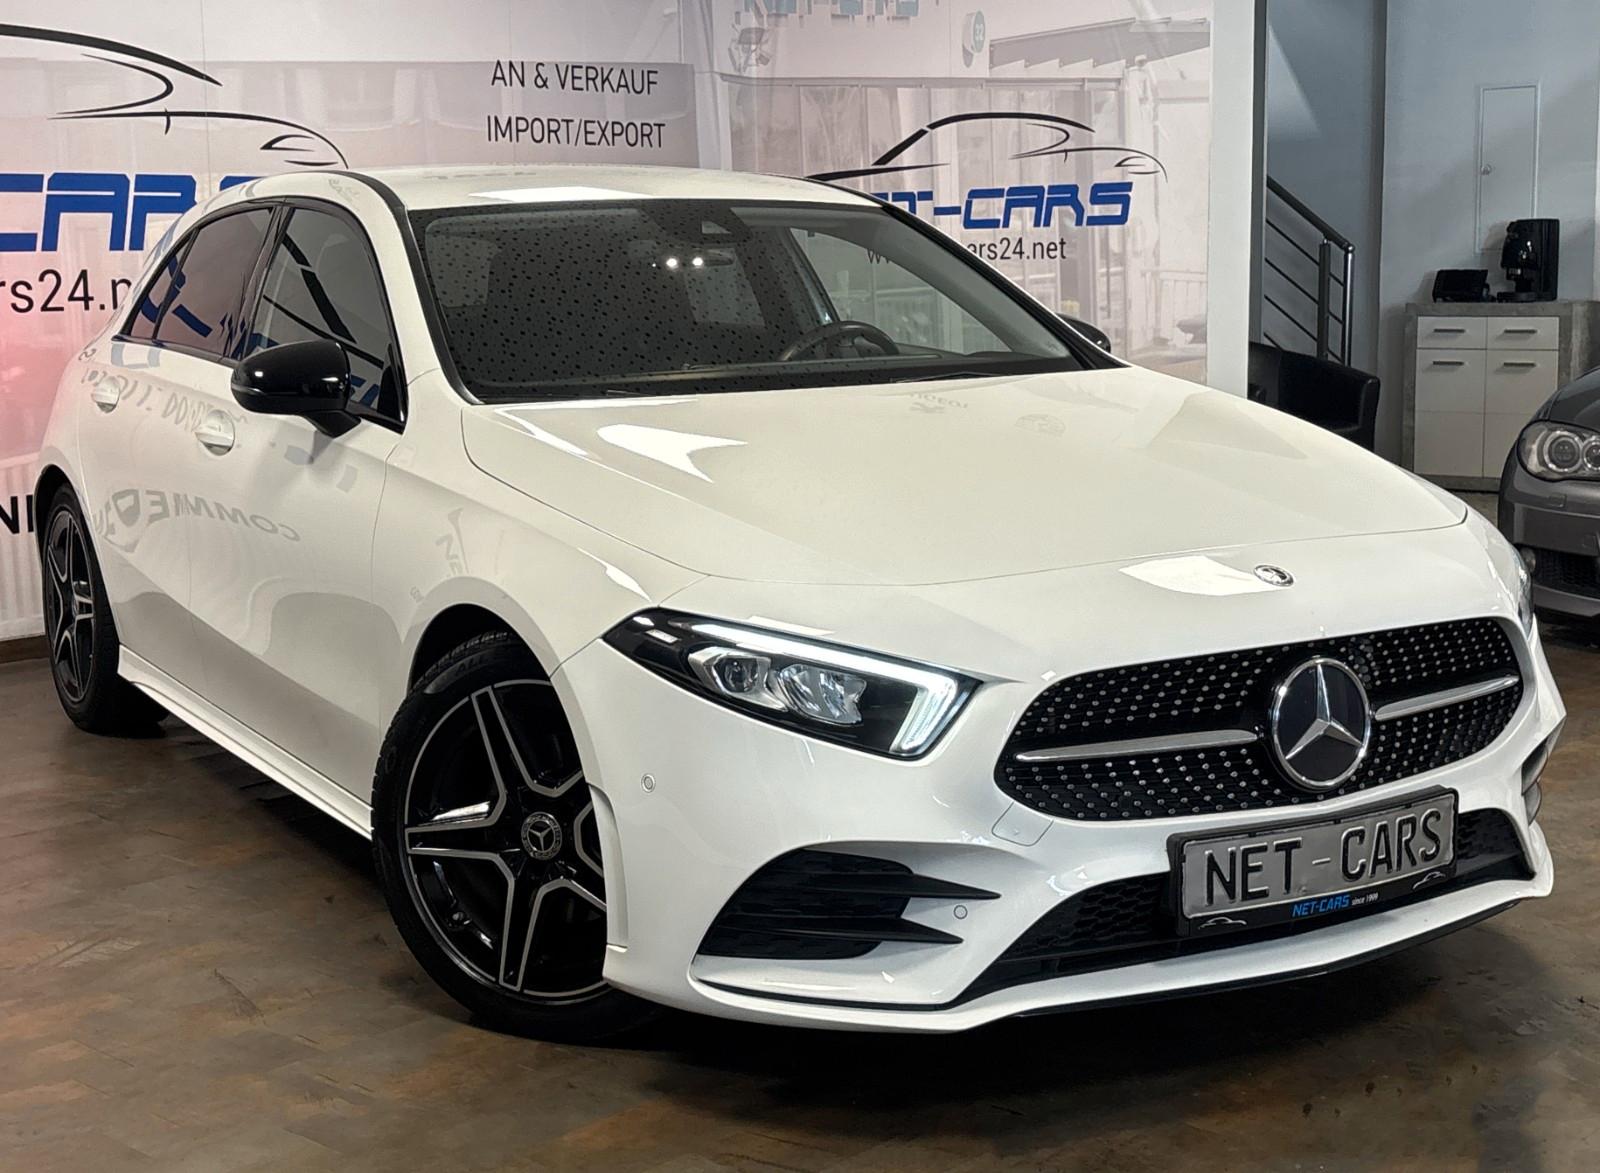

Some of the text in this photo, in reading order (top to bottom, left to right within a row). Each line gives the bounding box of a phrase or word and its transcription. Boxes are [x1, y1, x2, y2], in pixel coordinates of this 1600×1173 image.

[491, 60, 659, 95] AN & VERKAUF
[487, 115, 666, 148] IMPORT/EXPORT
[0, 172, 265, 252] AR
[871, 181, 1133, 230] T-CARS
[0, 268, 132, 314] s24.n
[1204, 837, 1303, 908] NET
[1341, 807, 1442, 882] CARS
[1291, 894, 1351, 918] NET-CARS
